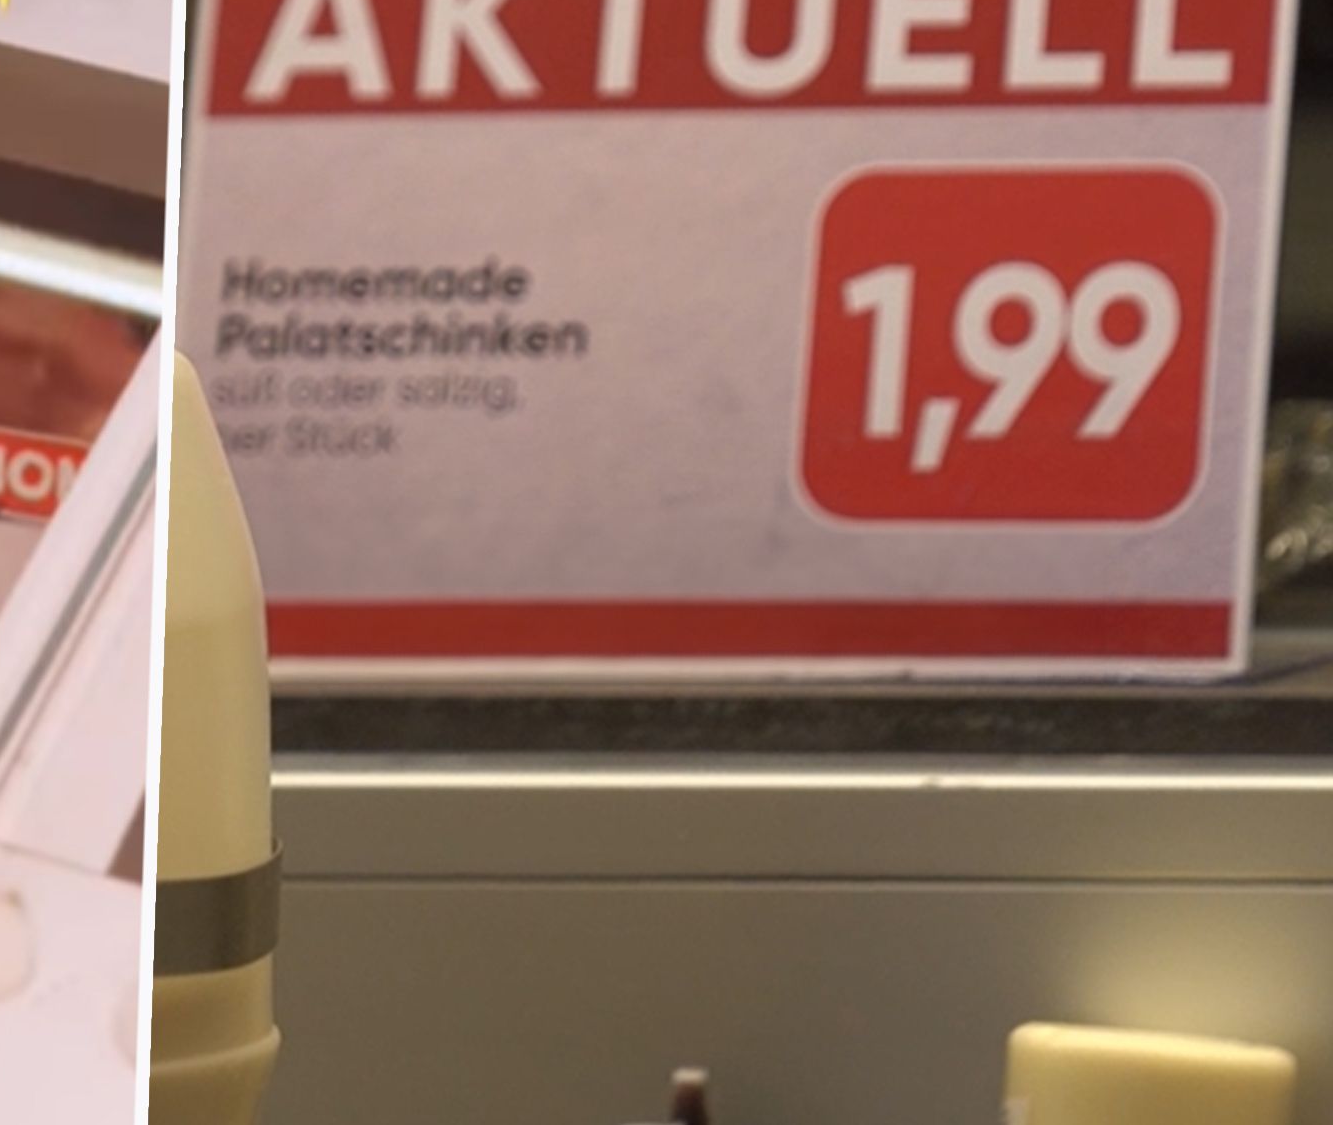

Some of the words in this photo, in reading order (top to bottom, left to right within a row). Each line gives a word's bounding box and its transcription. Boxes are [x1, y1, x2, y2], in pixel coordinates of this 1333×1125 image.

[220, 254, 530, 303] Homemade
[214, 309, 591, 358] Palatschinken
[288, 373, 382, 409] oder
[841, 260, 1181, 473] 1,99
[285, 415, 400, 457] Stück
